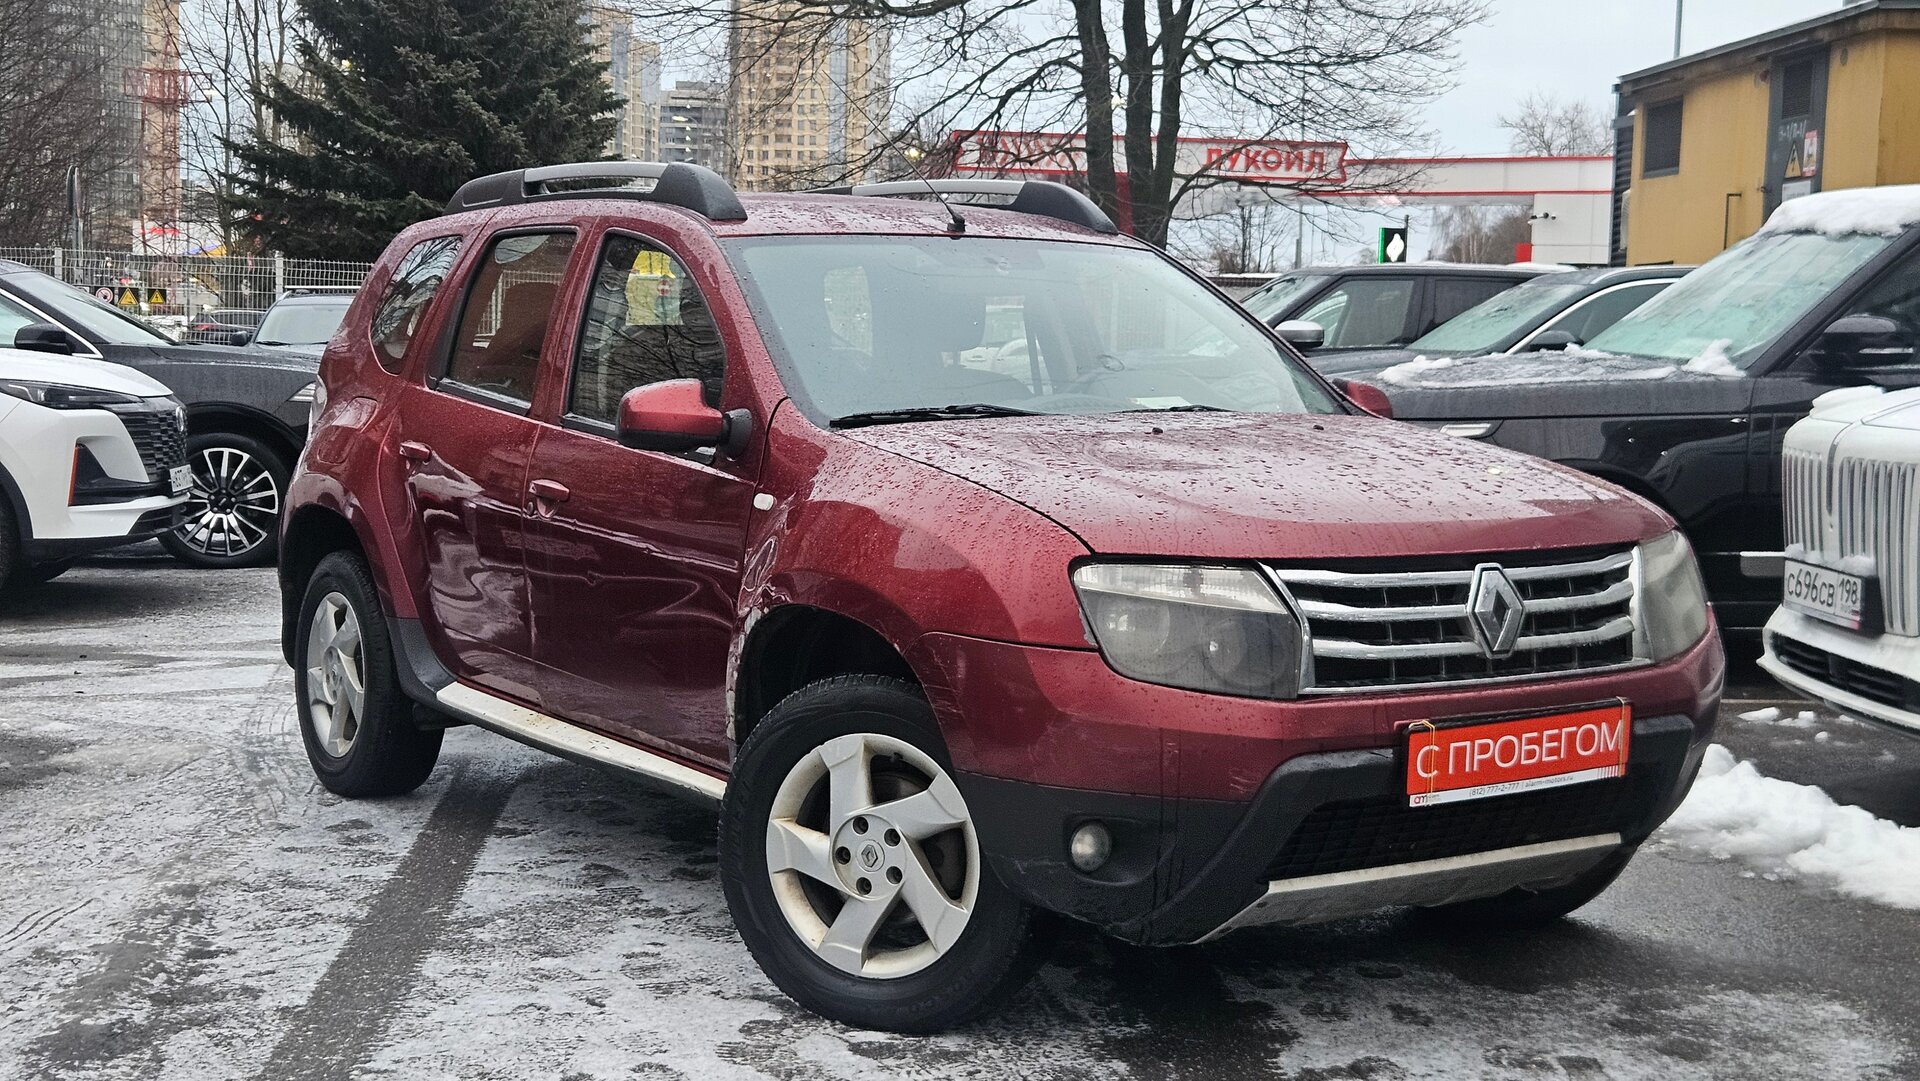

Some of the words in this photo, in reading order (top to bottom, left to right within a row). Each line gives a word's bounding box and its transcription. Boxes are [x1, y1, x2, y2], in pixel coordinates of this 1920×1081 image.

[1787, 568, 1835, 607] С696СВ
[1838, 578, 1859, 605] 198
[1416, 744, 1440, 778] С
[1448, 720, 1623, 775] ПРОБЕГОМ
[1487, 782, 1521, 796] 777-2-777
